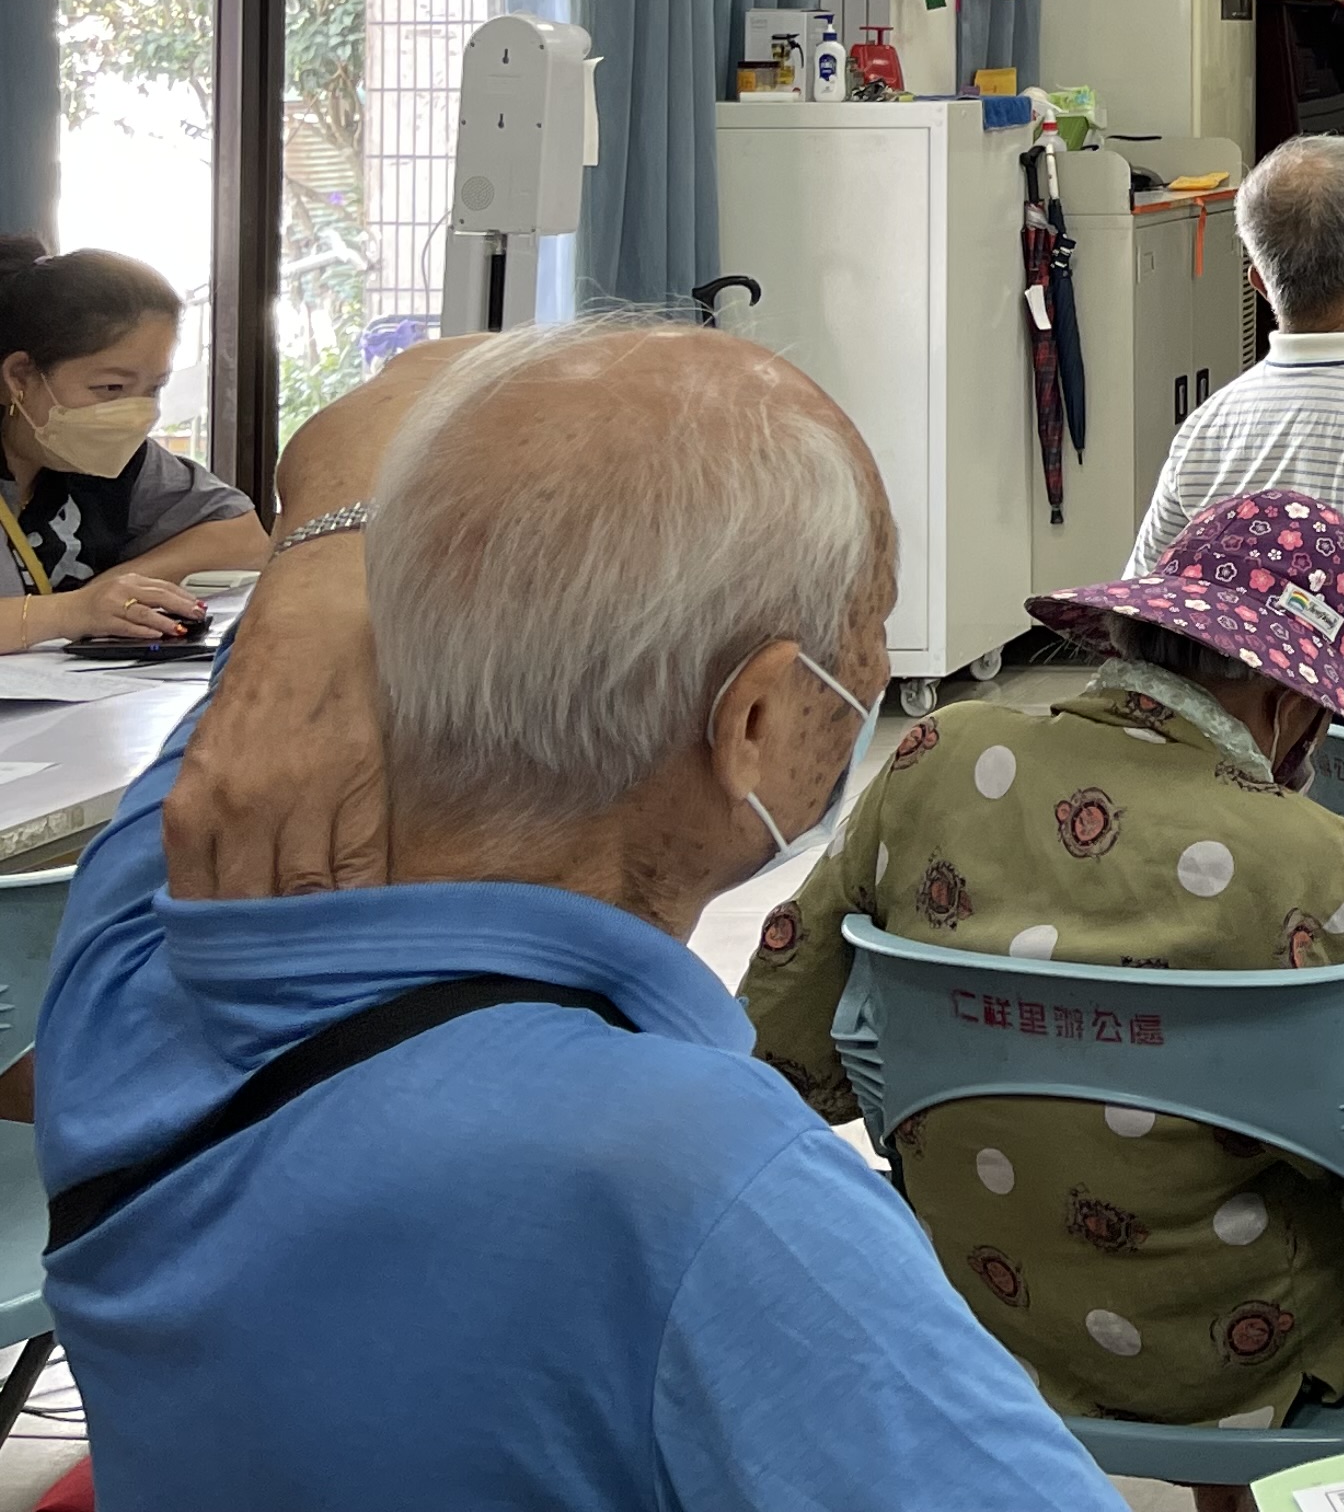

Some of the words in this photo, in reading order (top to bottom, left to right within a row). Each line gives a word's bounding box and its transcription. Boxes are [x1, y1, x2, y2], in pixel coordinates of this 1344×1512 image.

[952, 989, 1164, 1045] 仁祥里辦公處
